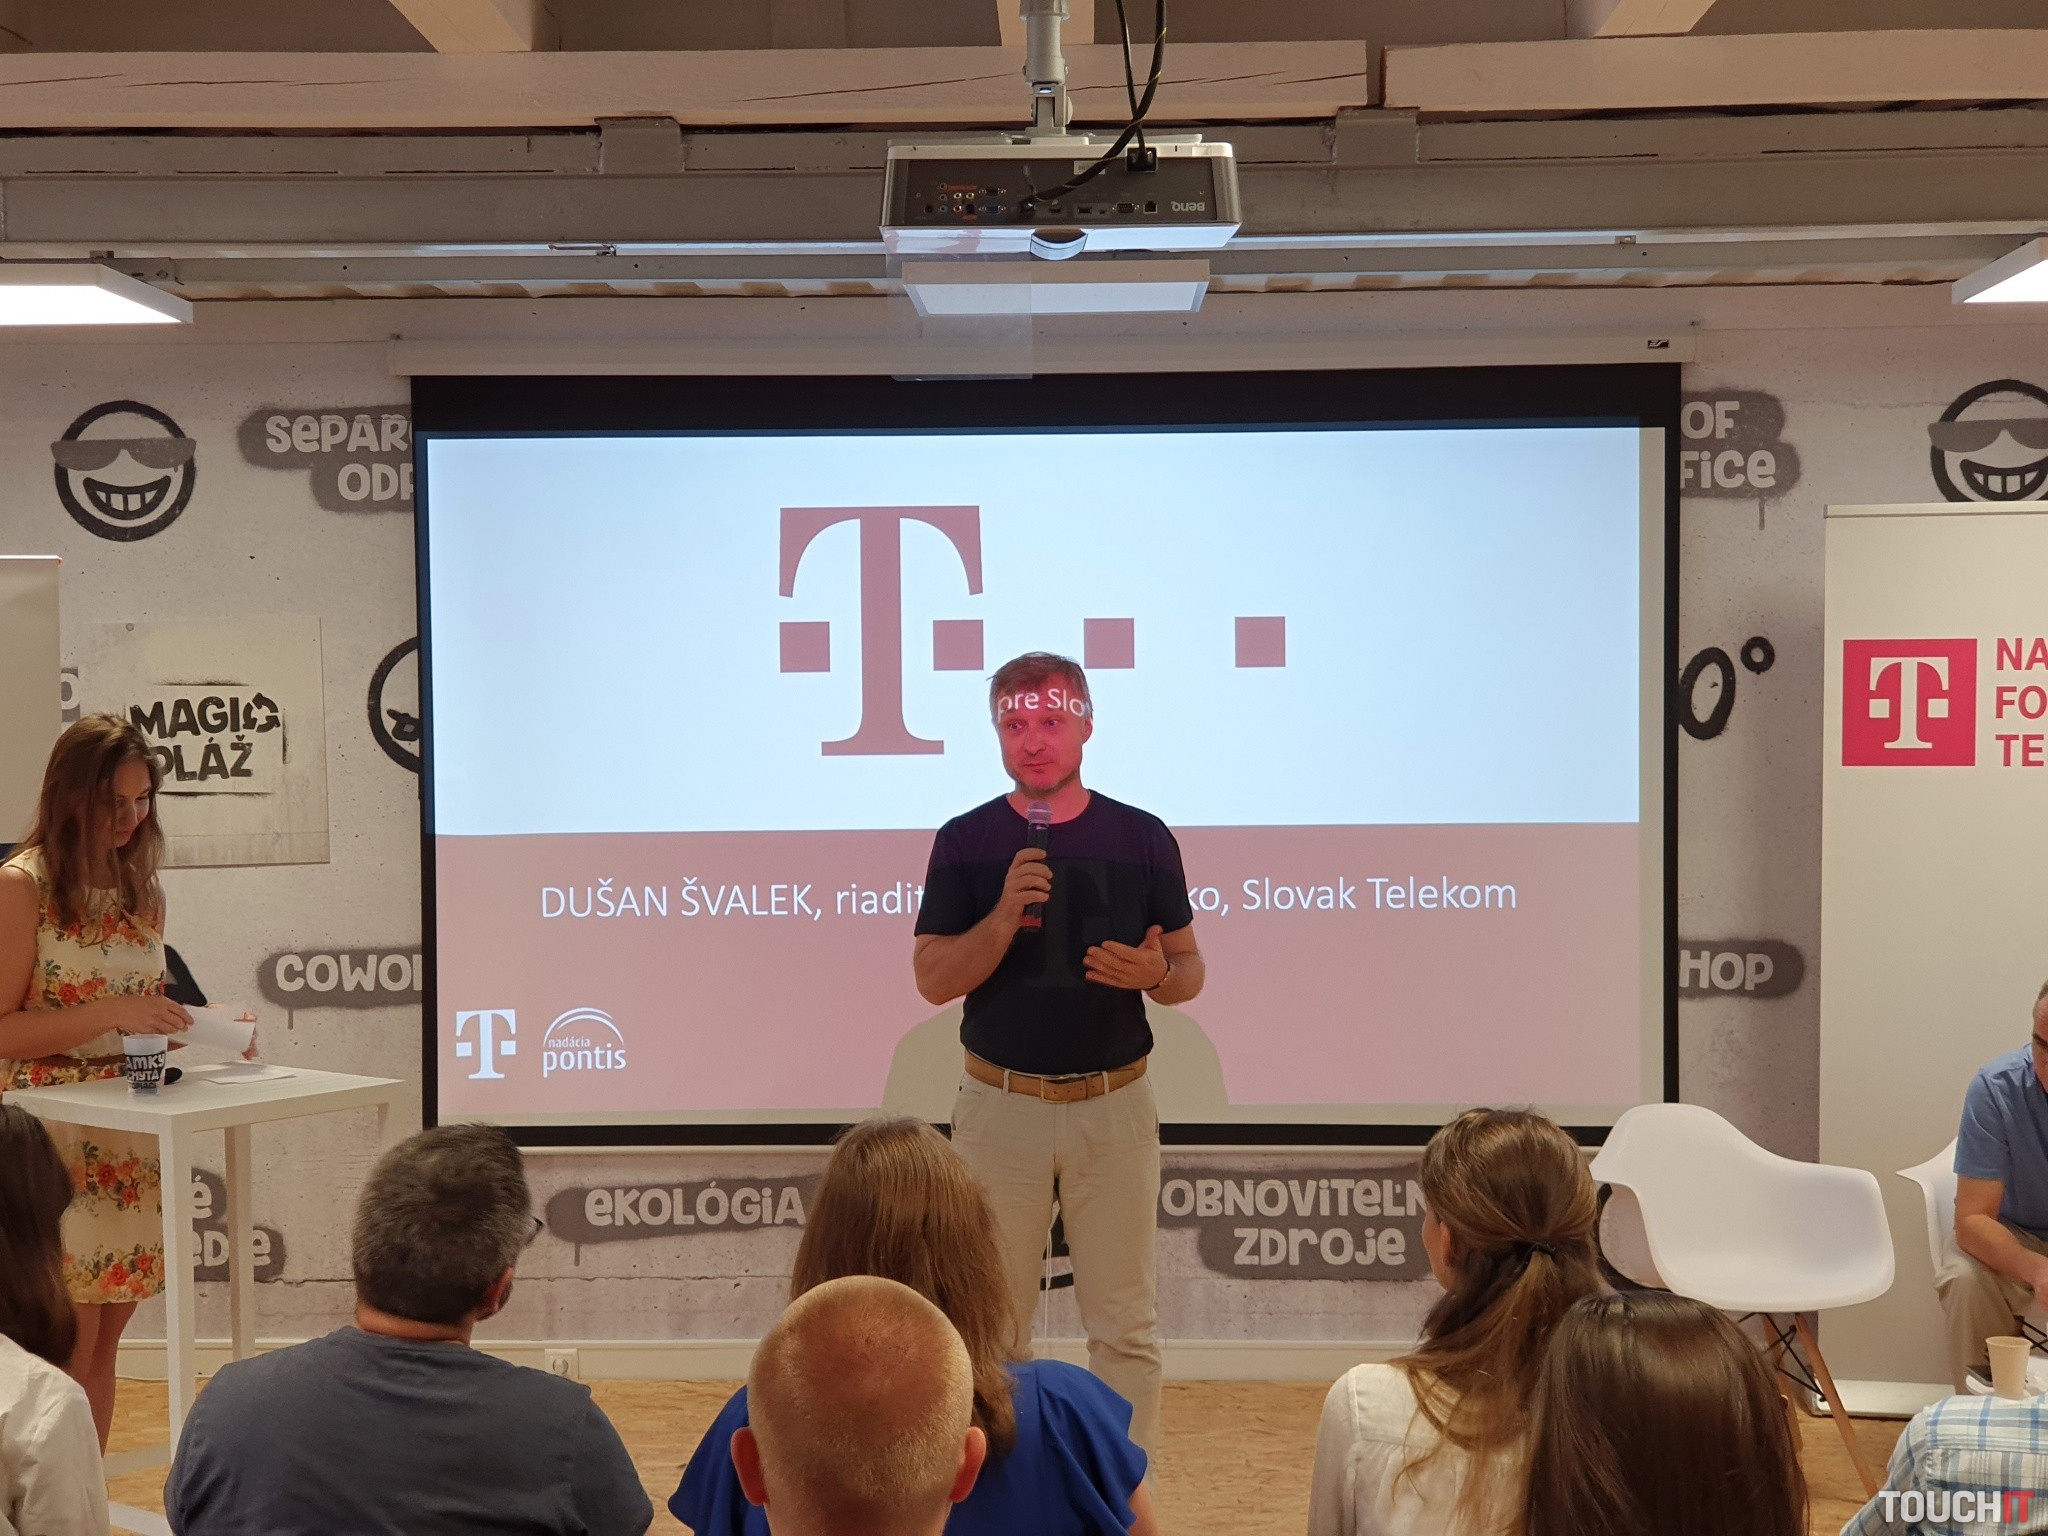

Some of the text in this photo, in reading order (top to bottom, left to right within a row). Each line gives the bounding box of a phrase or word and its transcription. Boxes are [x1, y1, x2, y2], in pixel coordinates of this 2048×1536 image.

[265, 413, 413, 453] SePAR
[1680, 400, 1740, 440] OF
[1996, 637, 2048, 671] NA
[1995, 685, 2048, 720] FO
[1994, 733, 2046, 768] TE
[541, 877, 668, 918] DUŠAN
[681, 876, 823, 922] ŠVALEK,
[1242, 876, 1357, 910] Slovak
[1366, 876, 1517, 909] Telekom
[1678, 949, 1774, 991] HOP
[542, 1042, 627, 1079] pontis
[548, 1036, 591, 1048] nadácia
